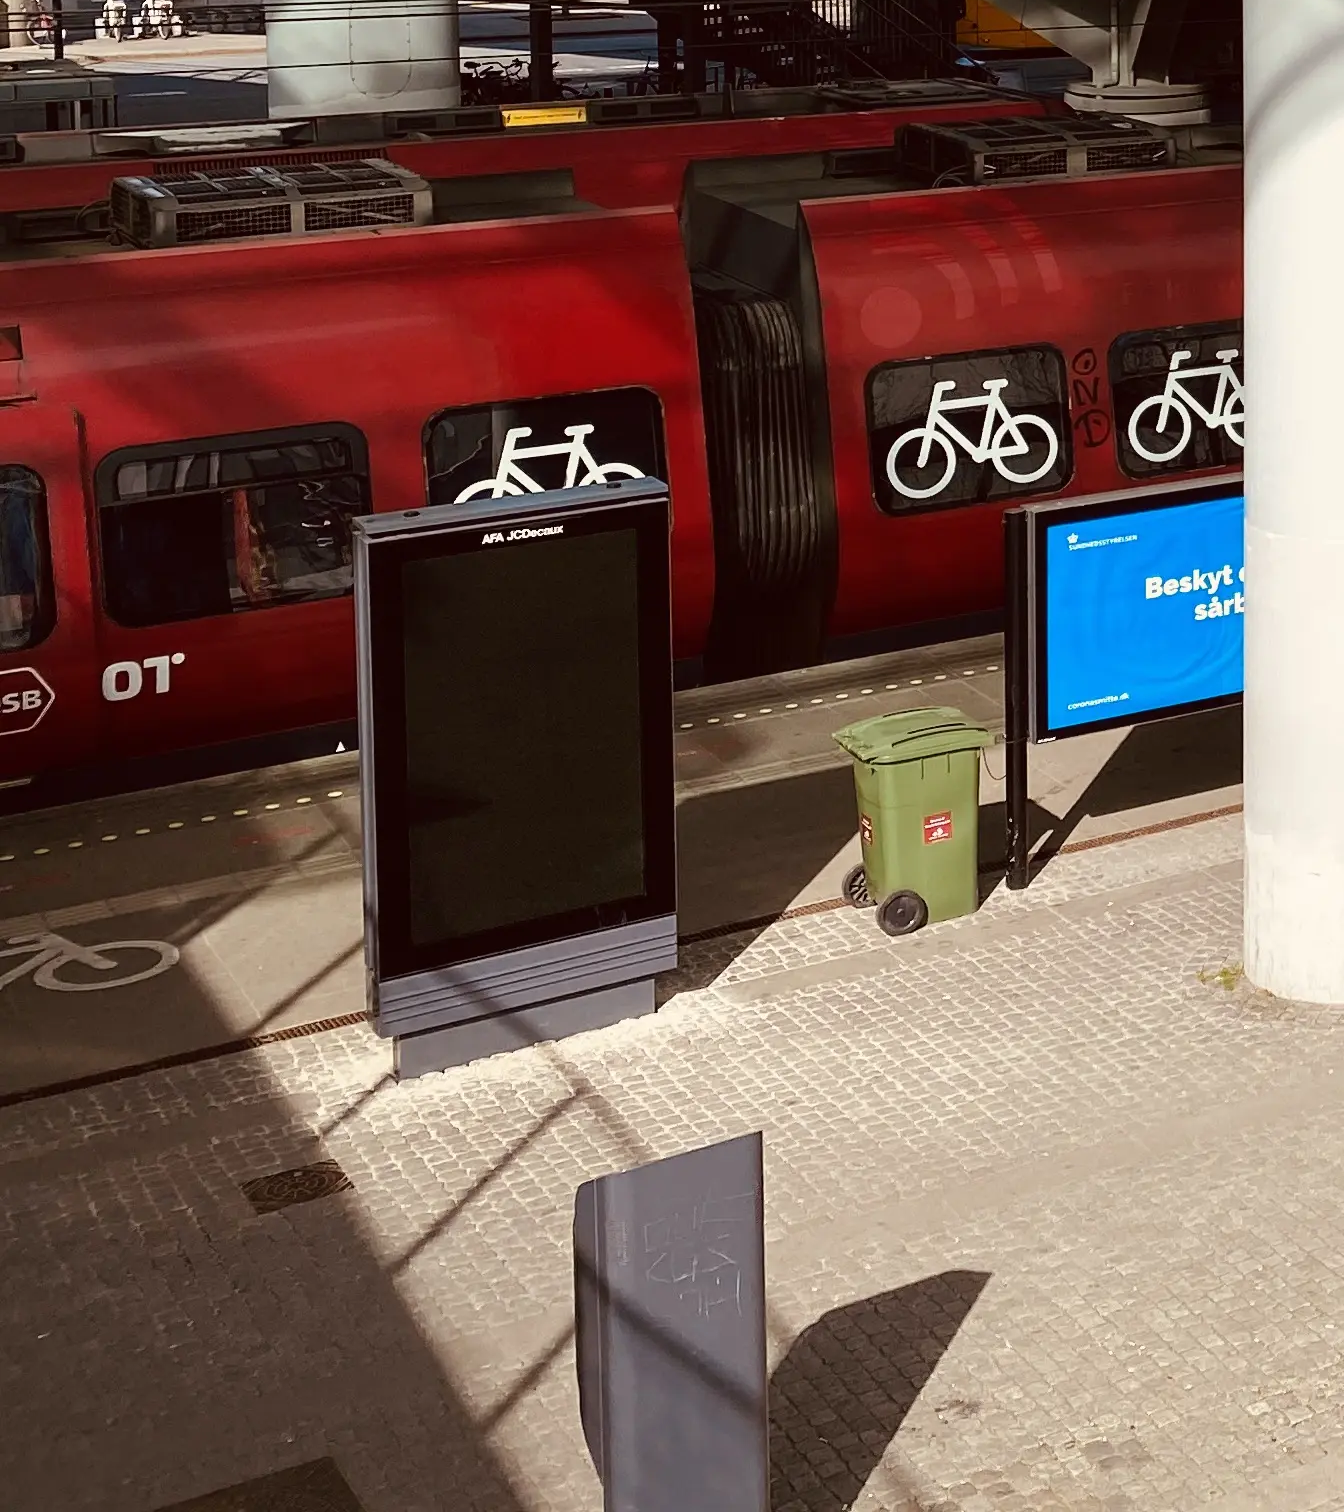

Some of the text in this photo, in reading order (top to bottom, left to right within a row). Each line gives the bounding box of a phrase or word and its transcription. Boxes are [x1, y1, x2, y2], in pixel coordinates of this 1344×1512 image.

[481, 532, 505, 545] AFA
[1145, 564, 1233, 600] Beskyt
[0, 689, 42, 714] SB
